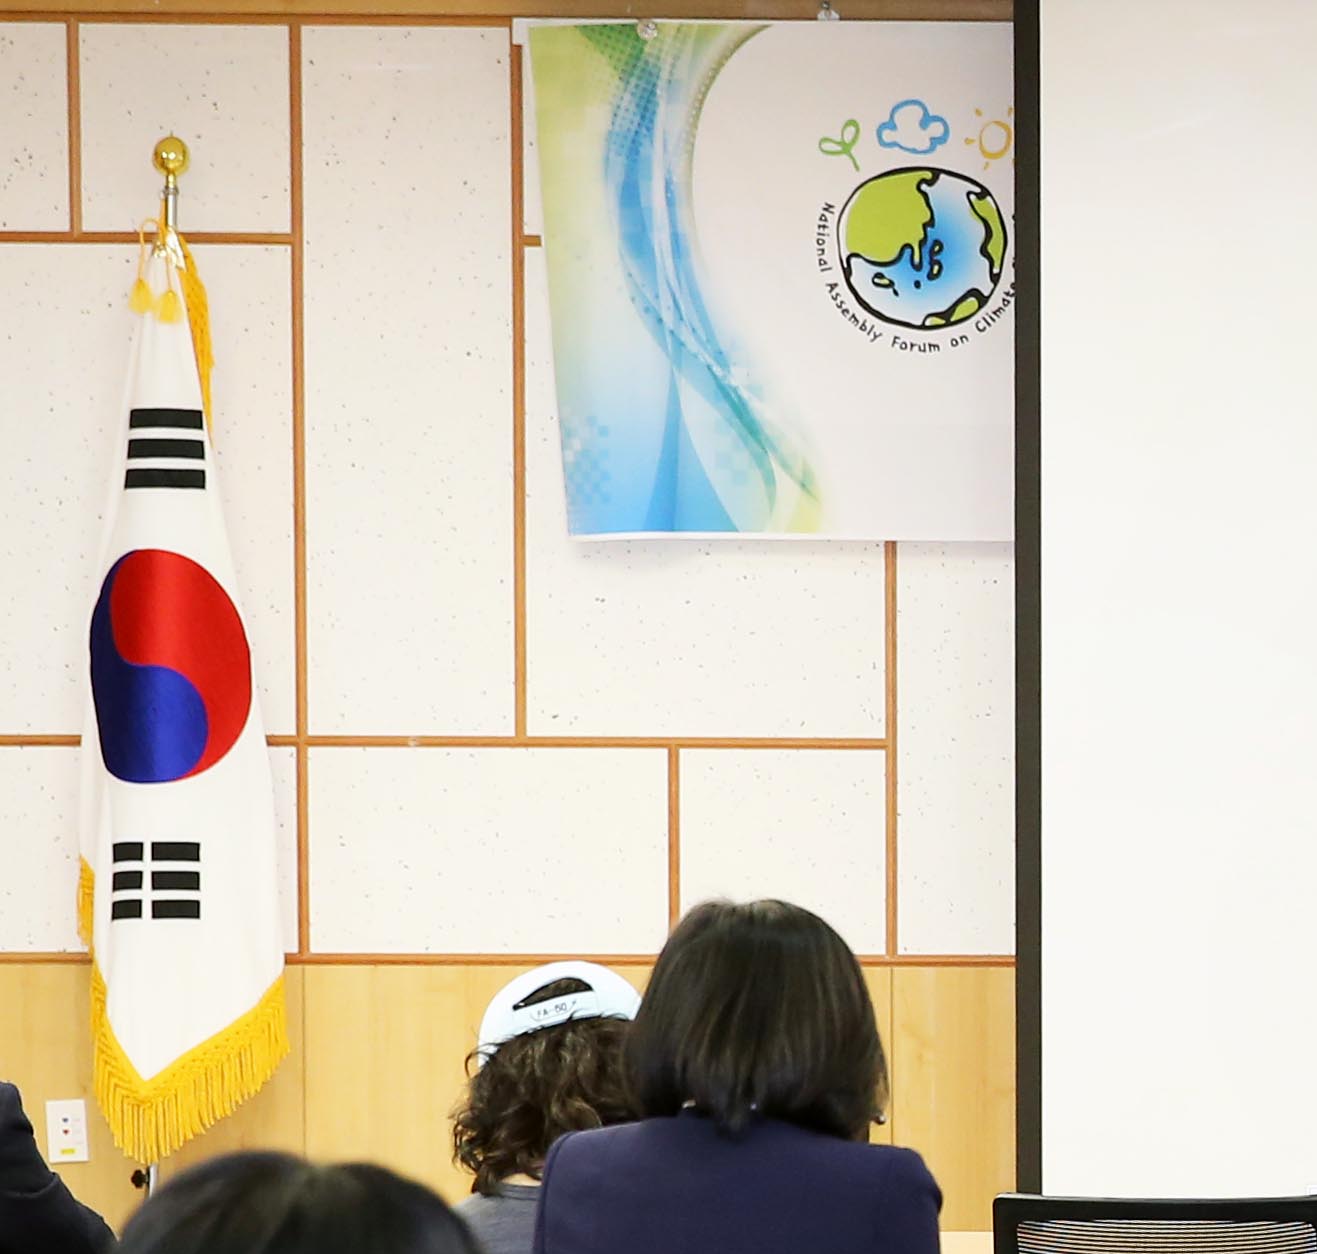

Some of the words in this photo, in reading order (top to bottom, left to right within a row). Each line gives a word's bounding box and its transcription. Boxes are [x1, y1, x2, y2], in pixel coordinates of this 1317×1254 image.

[816, 201, 836, 273] National
[825, 282, 883, 343] Assembly
[891, 335, 941, 353] Forum
[950, 334, 969, 348] on
